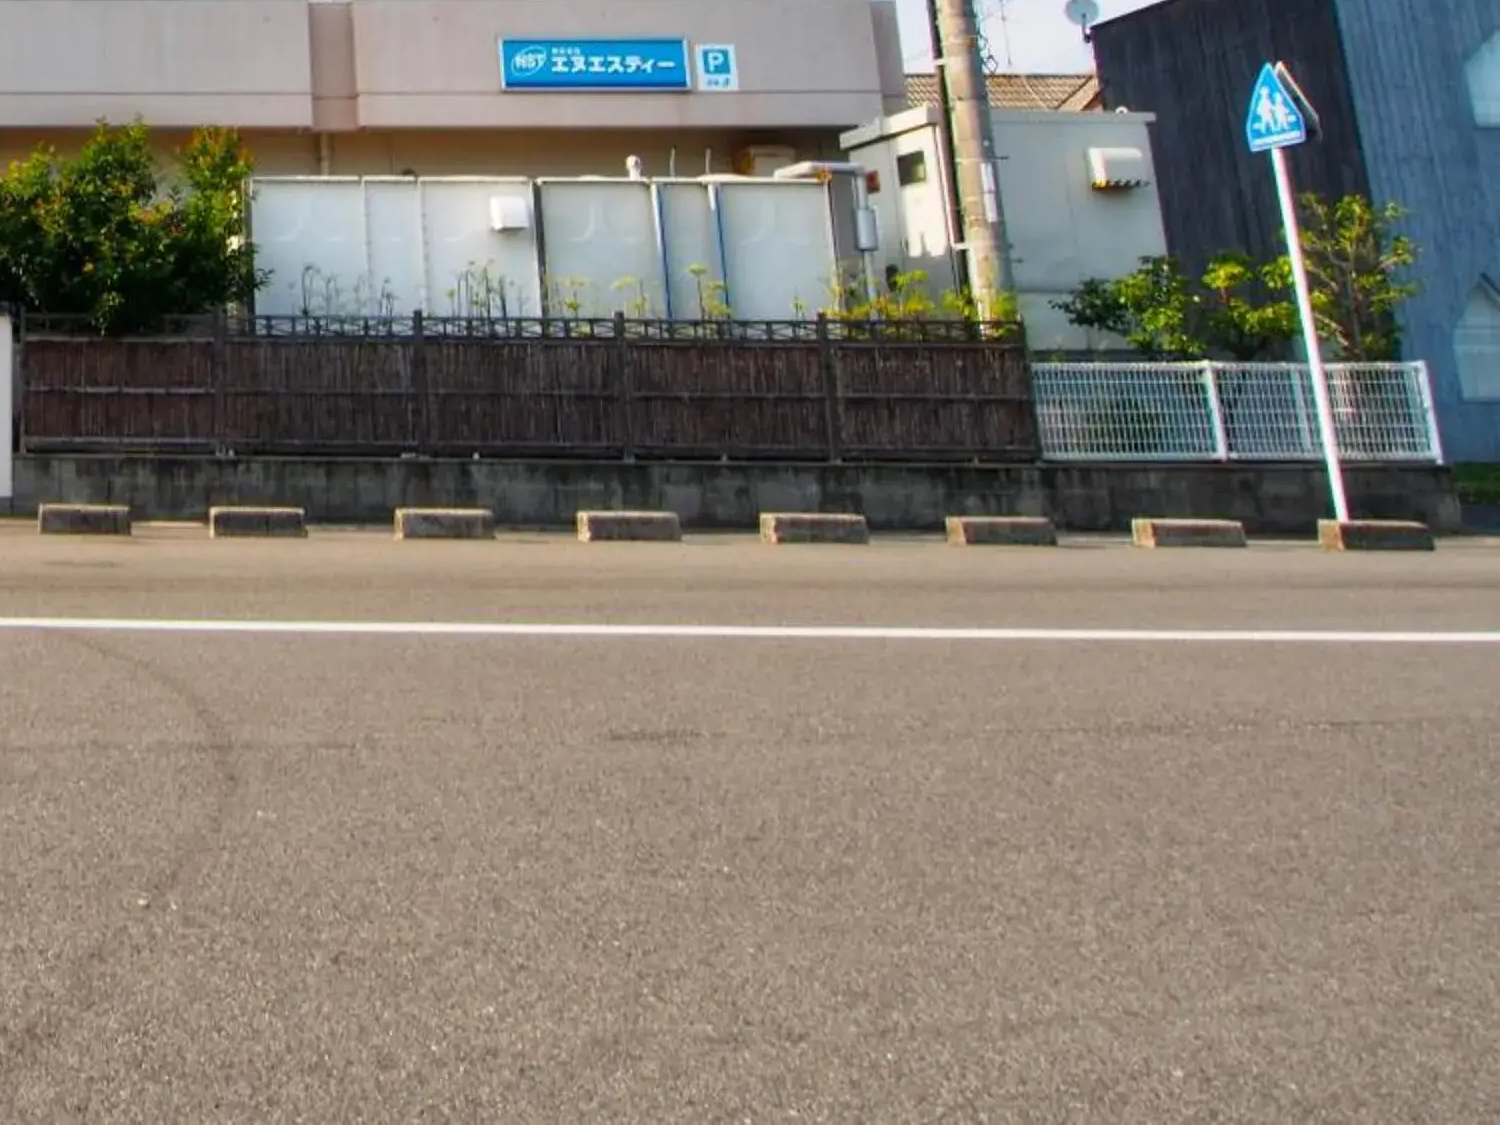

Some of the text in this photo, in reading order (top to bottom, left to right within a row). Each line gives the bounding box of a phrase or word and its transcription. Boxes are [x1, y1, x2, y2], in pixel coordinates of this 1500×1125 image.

[551, 56, 676, 73] エヌエスティー
[708, 52, 725, 73] P
